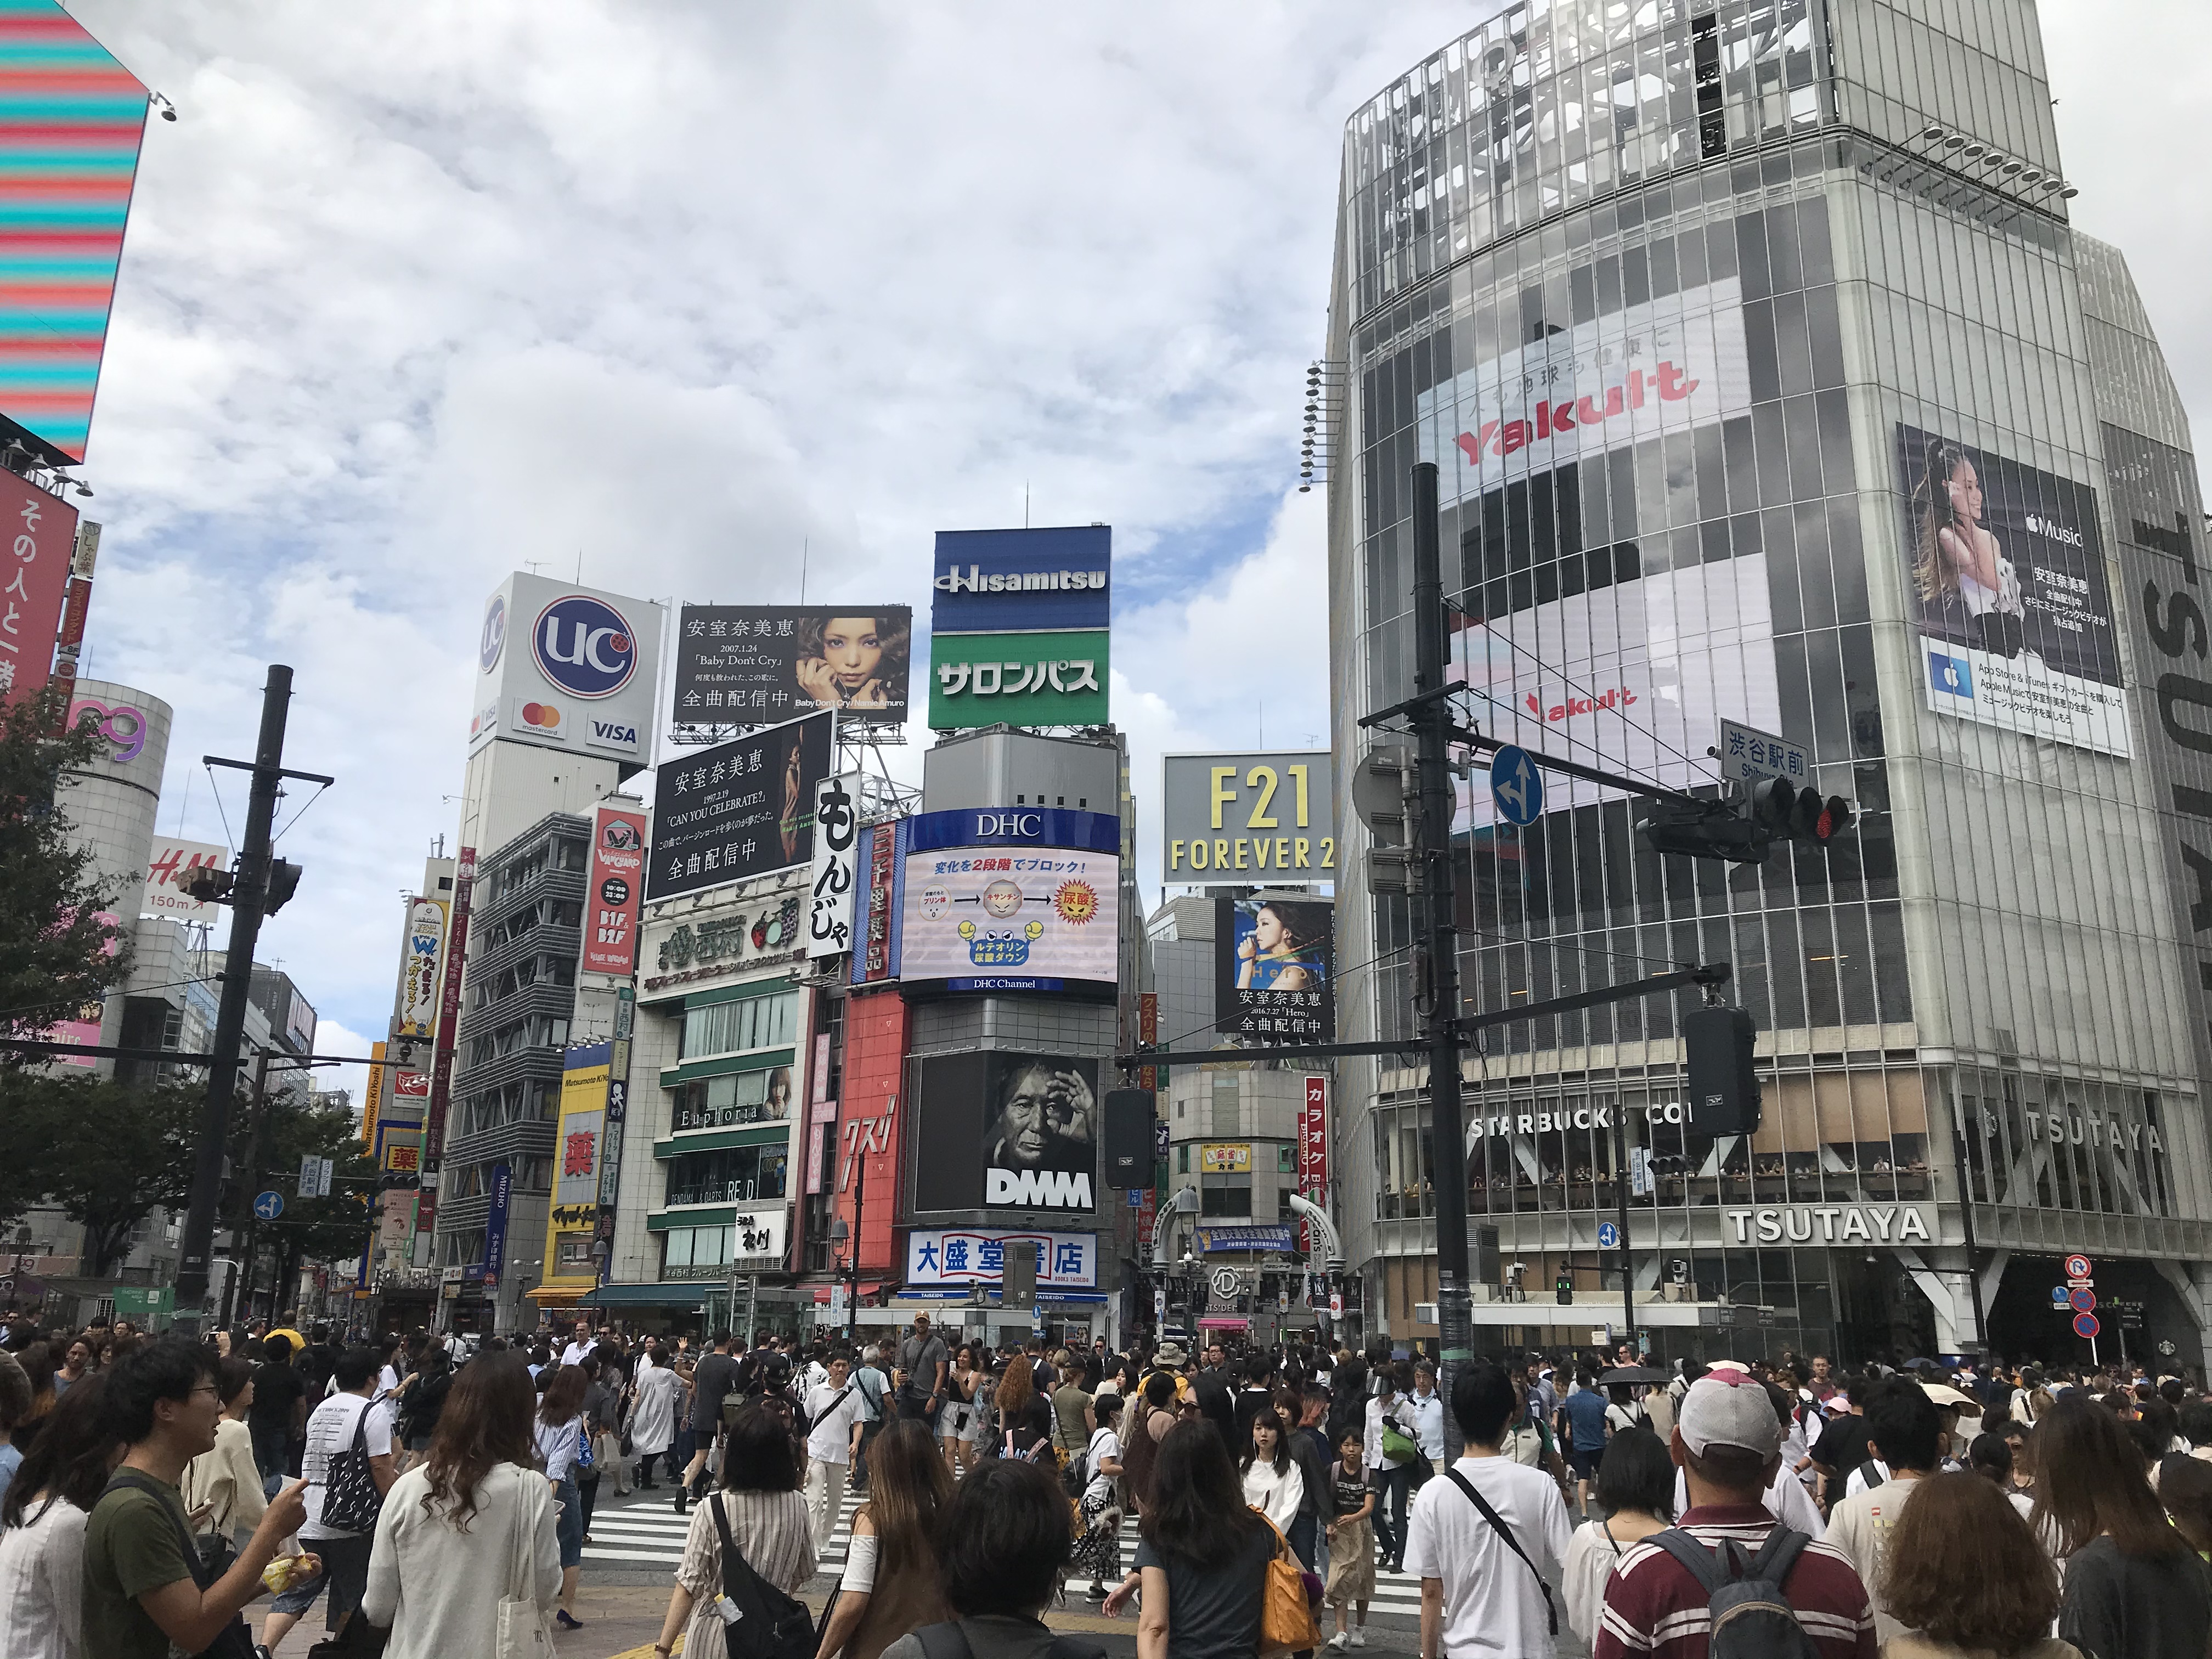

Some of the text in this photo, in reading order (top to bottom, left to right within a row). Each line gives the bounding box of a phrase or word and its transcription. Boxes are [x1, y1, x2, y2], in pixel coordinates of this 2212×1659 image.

[1469, 330, 1671, 419] 人も地球も健康に
[1453, 361, 1700, 467] Yakult
[2038, 516, 2084, 548] Music
[934, 565, 1106, 592] Hisamitsu
[2035, 567, 2088, 594] 安室奈美恵
[2046, 589, 2083, 608] 全曲配信中
[686, 619, 794, 637] 安室奈美恵
[2053, 616, 2083, 633] 独占追加
[720, 645, 757, 653] 2007.1.24
[728, 656, 755, 665] Don't
[695, 673, 779, 682] 何度も救われた、この歌に。
[937, 659, 1098, 695] サロンパス
[2017, 673, 2023, 682] &
[682, 690, 788, 707] 全曲配信中
[795, 699, 815, 707] Baby
[522, 720, 636, 743] mastercard VISA
[1730, 731, 1803, 776] 渋谷駅前
[674, 748, 763, 796] 安室奈美恵
[703, 789, 729, 804] 1997.2.19
[1211, 765, 1307, 829] F21
[690, 807, 708, 822] YOU
[976, 815, 1041, 837] DHC
[597, 849, 640, 868] VANGUARD
[668, 839, 757, 881] 全曲配信中
[1171, 838, 1311, 870] FOREVER
[814, 779, 854, 949] もんじゃ
[606, 884, 627, 893] 10:00
[150, 895, 189, 910] 150m
[1063, 891, 1090, 906] 尿酸
[600, 910, 627, 927] B1F
[597, 927, 627, 945] B2F
[975, 942, 1025, 952] ルテオリン
[974, 952, 1025, 963] 尿酸ダウン
[1252, 966, 1308, 979] Hero
[974, 979, 1036, 988] DHC Channel
[1239, 990, 1322, 1006] 安室奈美恵
[1282, 1007, 1310, 1017] 「Hero」
[1240, 1017, 1321, 1033] 全曲配信中
[565, 1077, 596, 1087] Matsumoto
[681, 1107, 758, 1128] Euphoria
[1308, 1088, 1324, 1164] カラオケ
[2026, 1110, 2164, 1153] TSUTAYA
[393, 1148, 417, 1169] 薬
[565, 1131, 595, 1176] 薬
[497, 1175, 507, 1208] MIZUHO
[704, 1191, 722, 1203] DARTS
[986, 1168, 1093, 1208] DMM
[1728, 1207, 1929, 1242] TSUTAYA
[489, 1233, 500, 1269] みずほ銀行
